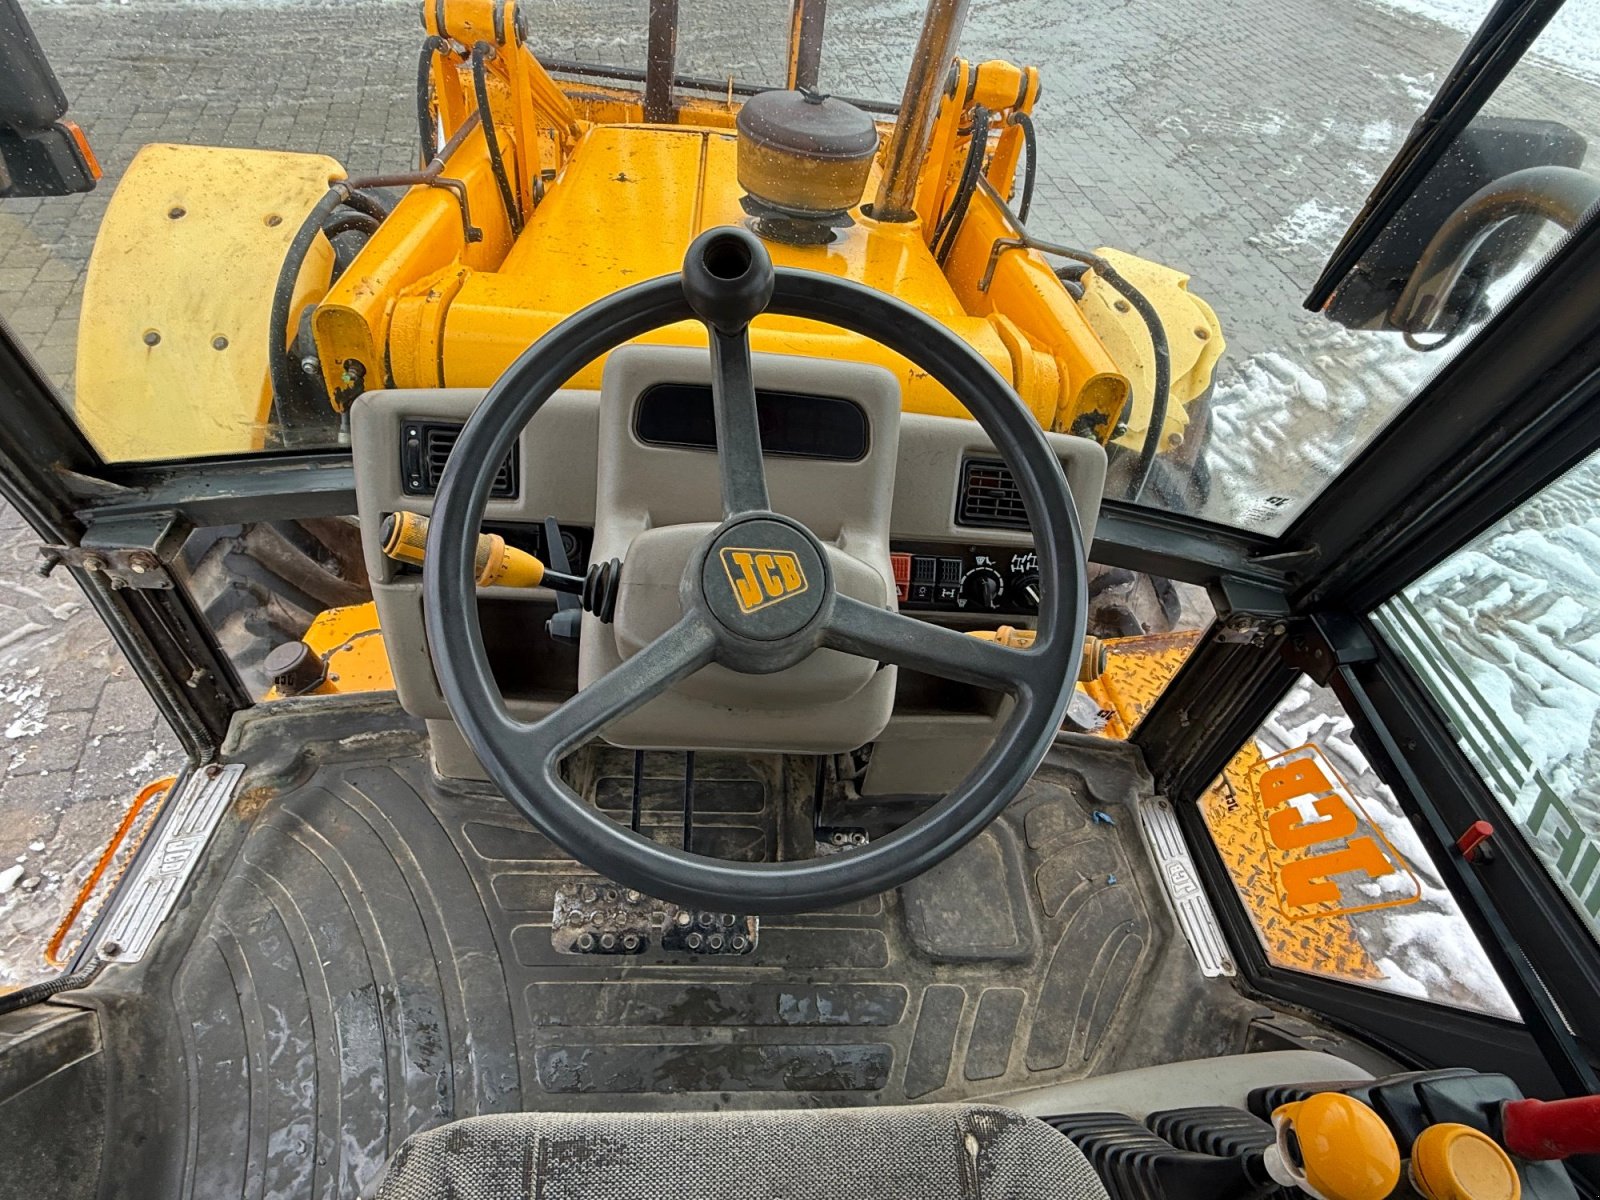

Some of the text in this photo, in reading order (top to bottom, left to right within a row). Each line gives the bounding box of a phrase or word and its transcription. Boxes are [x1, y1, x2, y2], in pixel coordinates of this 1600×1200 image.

[731, 552, 802, 609] JCB
[161, 840, 199, 873] JCB
[1169, 863, 1197, 896] JCB
